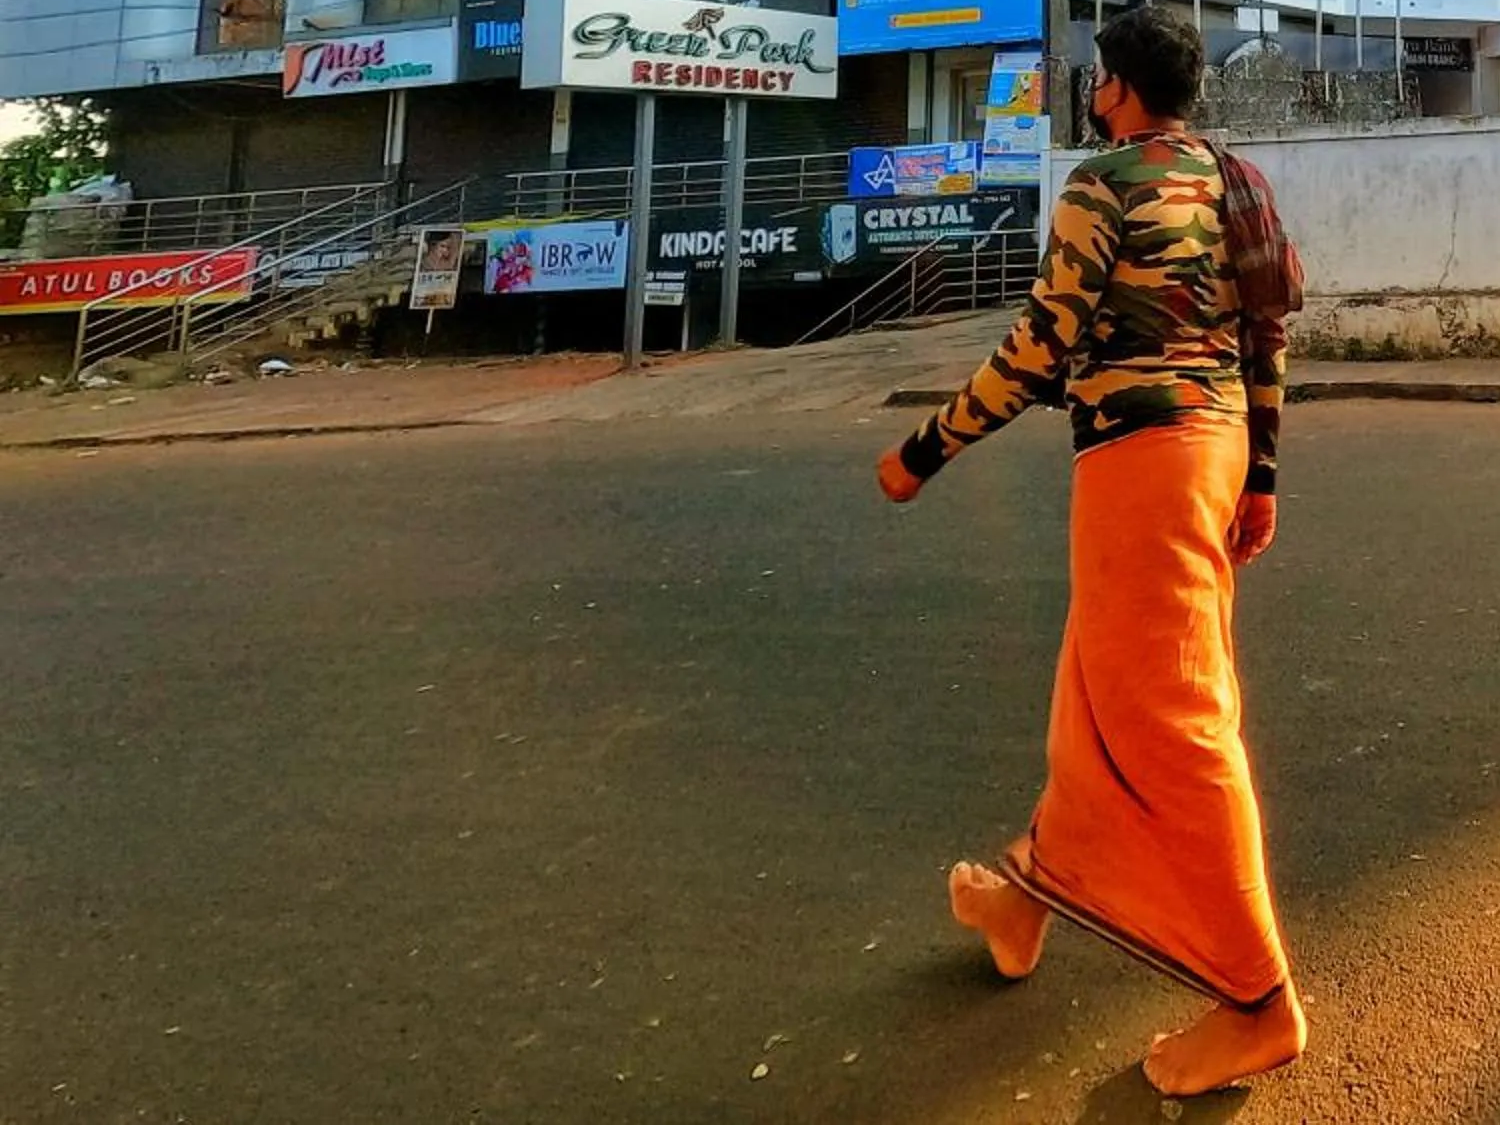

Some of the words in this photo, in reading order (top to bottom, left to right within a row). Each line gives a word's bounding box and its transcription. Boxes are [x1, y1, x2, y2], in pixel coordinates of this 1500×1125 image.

[573, 13, 711, 59] Green
[716, 25, 835, 73] Park
[631, 60, 796, 92] RESIDENCY
[863, 203, 975, 229] CRYSTAL
[659, 229, 727, 258] KINDA
[738, 227, 799, 254] CAFE
[21, 272, 97, 296] ATUL
[108, 264, 214, 291] BOOKS
